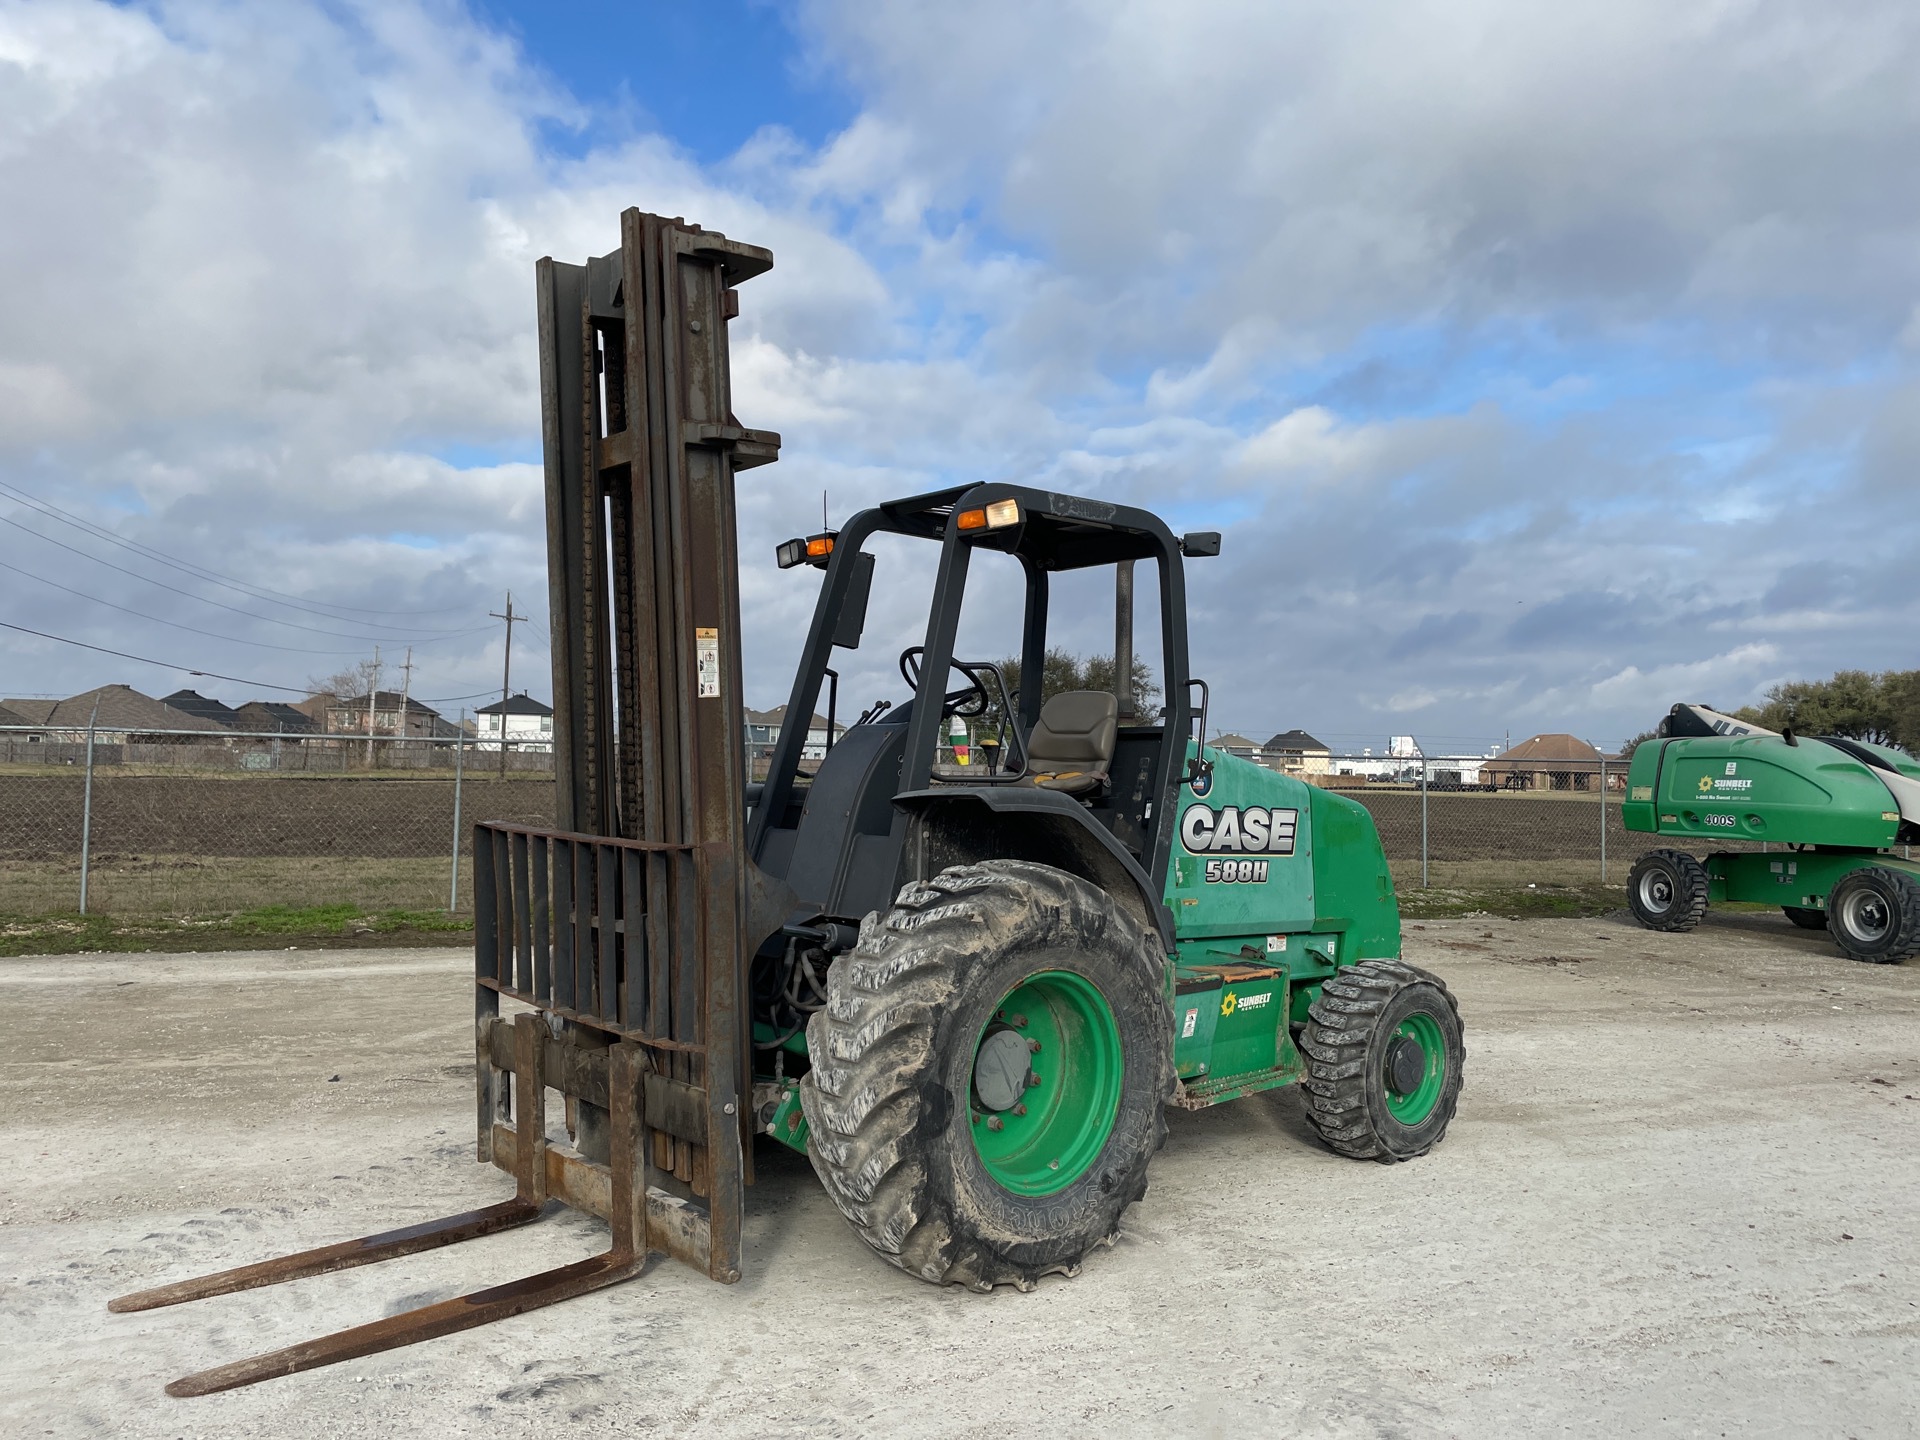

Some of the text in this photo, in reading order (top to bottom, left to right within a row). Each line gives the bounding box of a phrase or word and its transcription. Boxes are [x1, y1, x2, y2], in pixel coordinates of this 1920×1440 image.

[1714, 779, 1752, 788] SUNBELT
[1704, 813, 1736, 827] 400S
[1181, 803, 1298, 853] CASE
[1205, 859, 1269, 883] 588H
[1237, 992, 1272, 1009] SUNBELT
[1241, 1003, 1266, 1012] RENTALS
